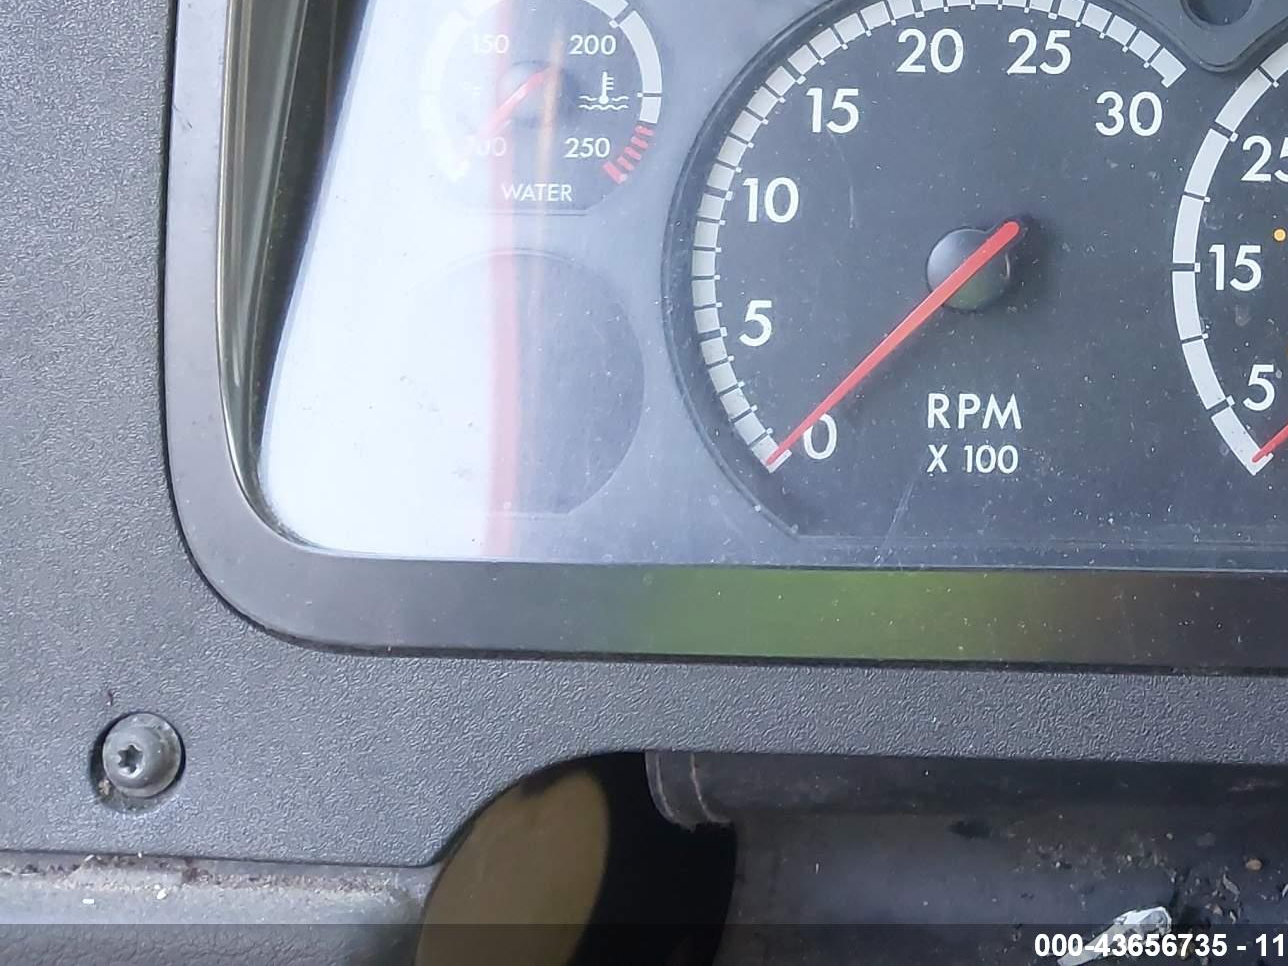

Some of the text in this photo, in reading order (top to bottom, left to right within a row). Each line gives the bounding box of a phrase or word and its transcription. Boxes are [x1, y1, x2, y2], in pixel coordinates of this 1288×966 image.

[569, 34, 617, 55] 200
[897, 29, 965, 73] 20
[1007, 30, 1072, 74] 25
[806, 88, 860, 133] 15
[1095, 91, 1163, 136] 30
[564, 137, 611, 159] 250
[502, 183, 573, 202] WATER
[742, 177, 799, 222] 10
[1209, 245, 1262, 291] 15
[739, 301, 773, 347] 5
[1243, 365, 1275, 411] 5
[927, 394, 1022, 430] RPM
[803, 414, 837, 459] 0
[927, 445, 1019, 474] X 100
